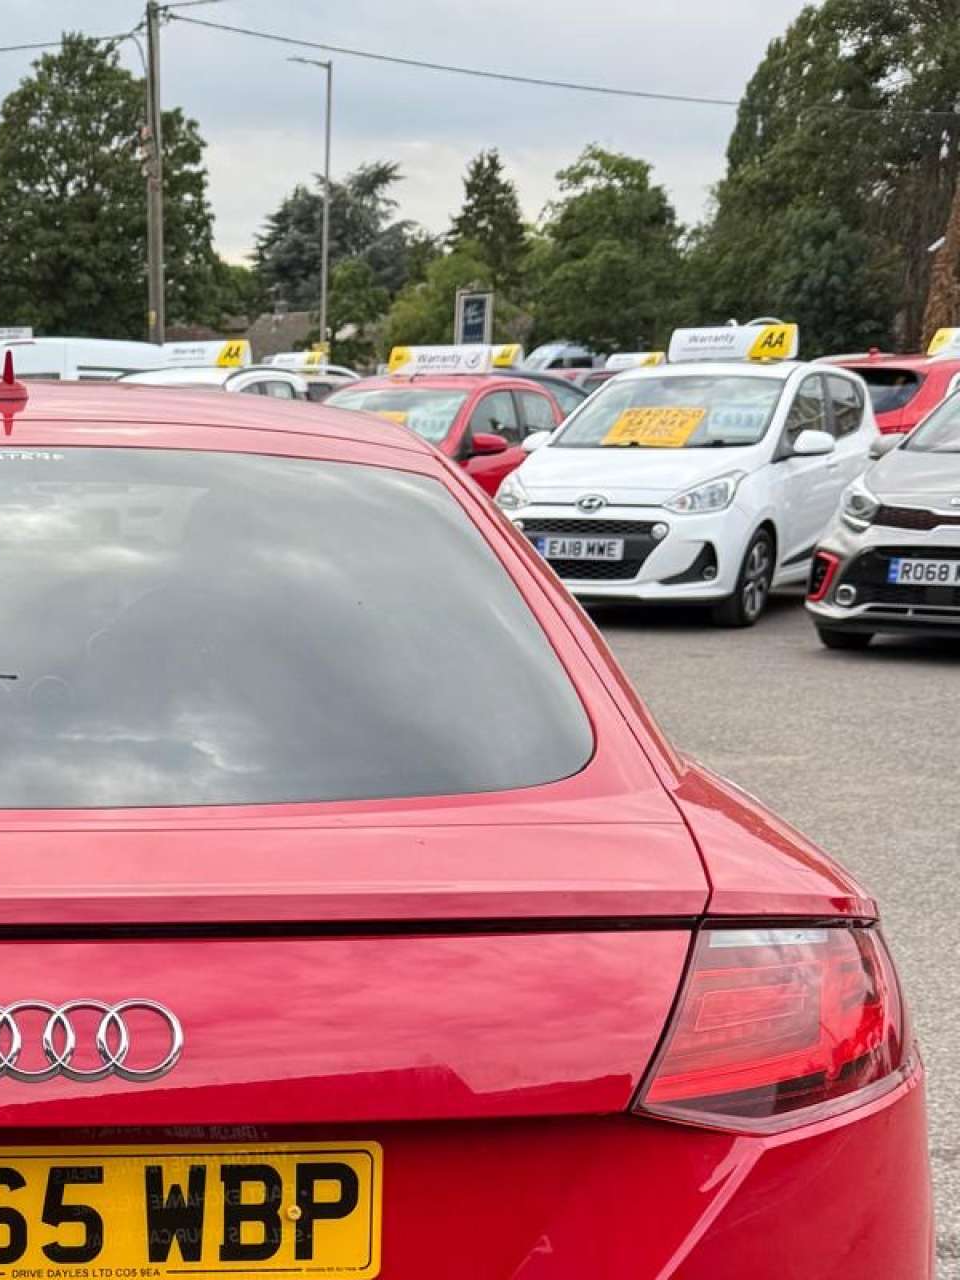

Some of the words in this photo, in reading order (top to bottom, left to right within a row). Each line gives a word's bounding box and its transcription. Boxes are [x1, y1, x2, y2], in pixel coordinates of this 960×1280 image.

[760, 331, 786, 348] AA
[548, 540, 582, 557] EA18
[586, 541, 617, 558] MWE
[144, 1163, 359, 1263] WBP
[11, 1269, 42, 1279] DRIVE
[47, 1268, 89, 1278] DAYLES
[92, 1268, 113, 1278] LTD
